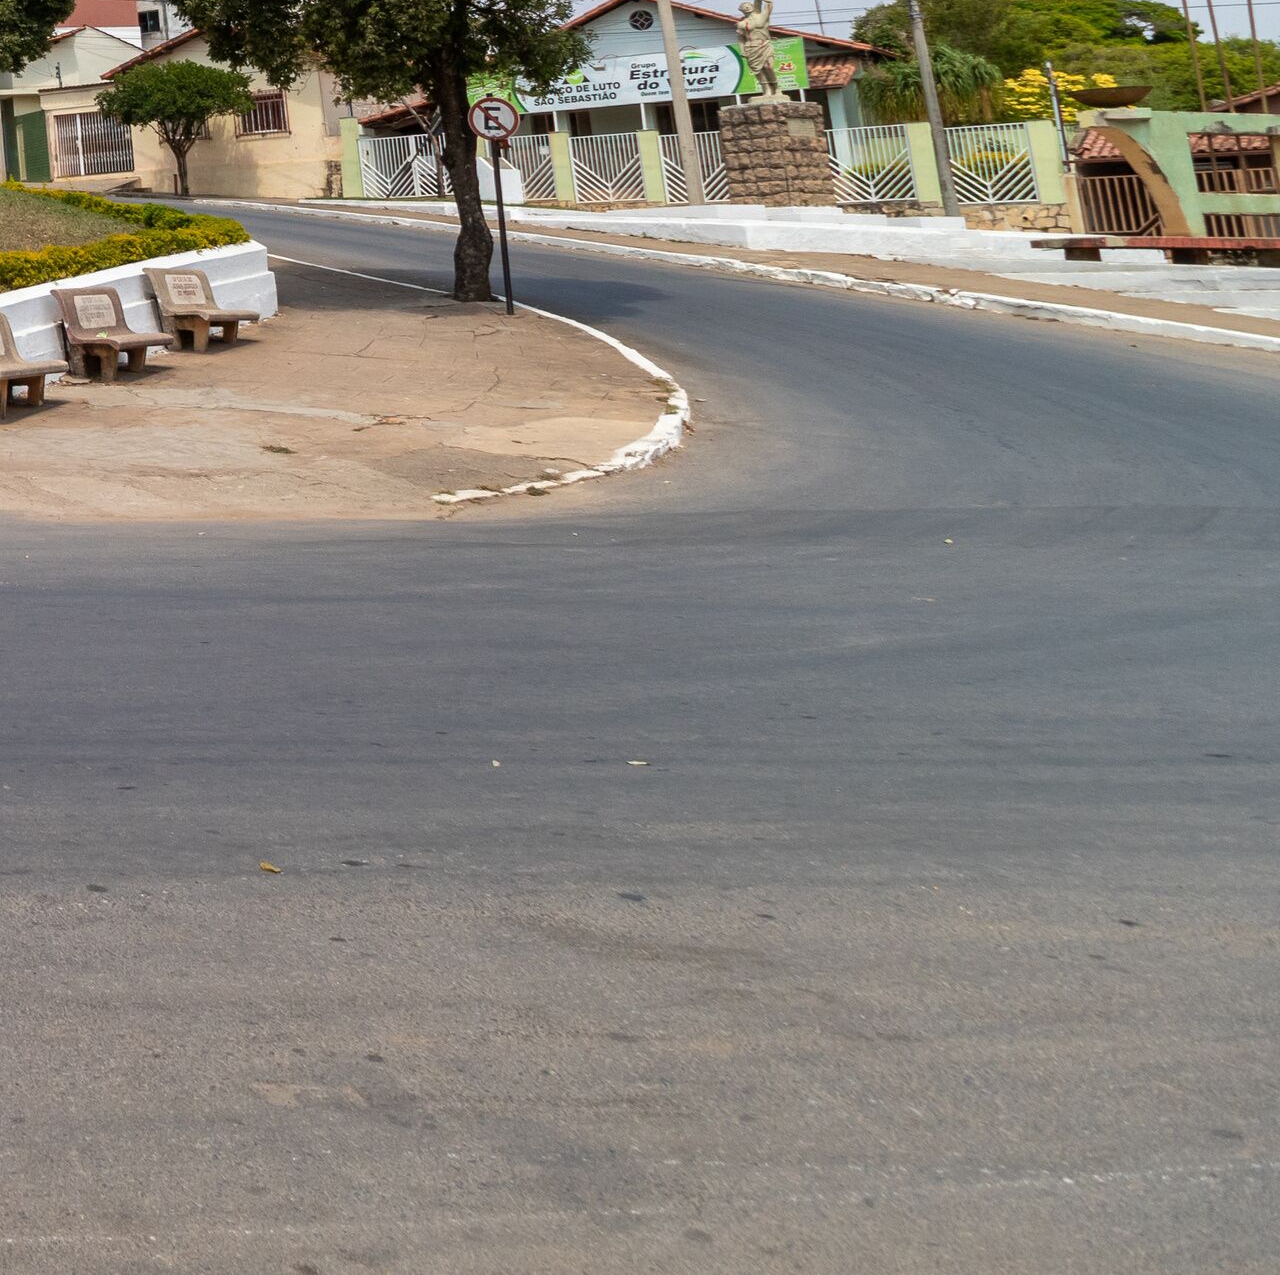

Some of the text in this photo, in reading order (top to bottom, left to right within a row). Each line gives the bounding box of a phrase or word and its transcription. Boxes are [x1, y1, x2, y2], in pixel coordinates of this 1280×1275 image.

[630, 64, 719, 80] Estrtura
[576, 84, 589, 93] DE
[593, 82, 620, 91] LUTO
[637, 80, 659, 90] do
[558, 91, 617, 104] SEBASTIÃO
